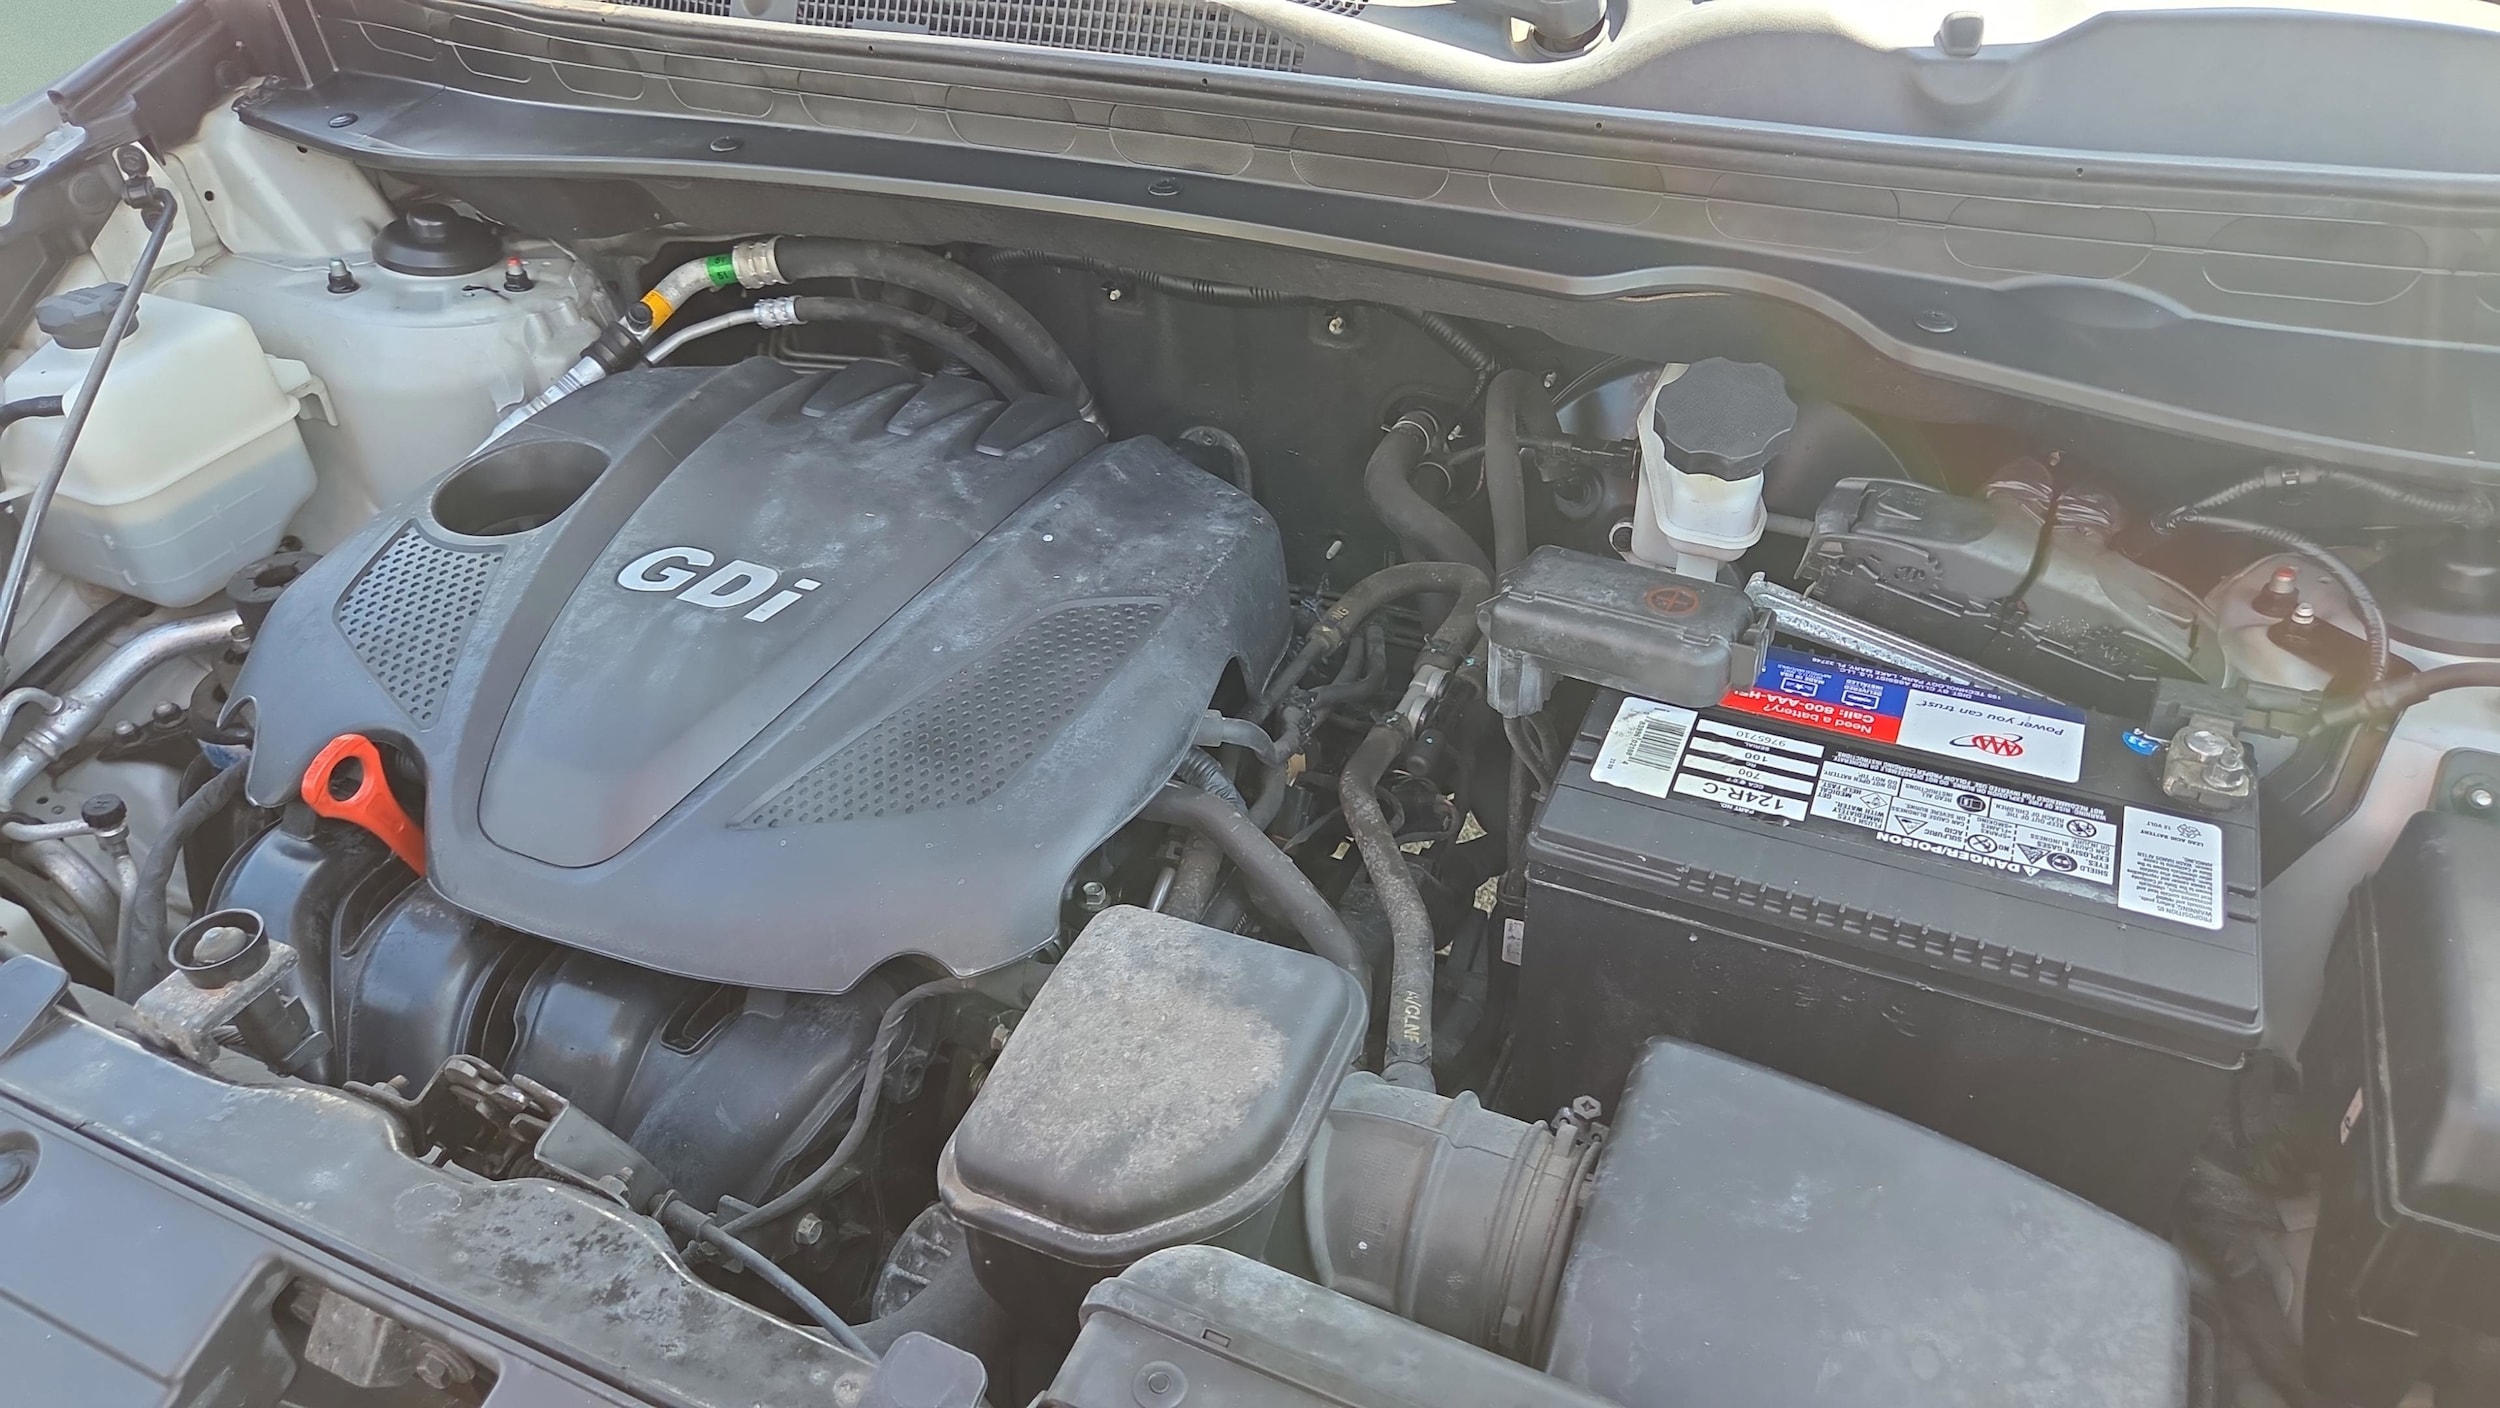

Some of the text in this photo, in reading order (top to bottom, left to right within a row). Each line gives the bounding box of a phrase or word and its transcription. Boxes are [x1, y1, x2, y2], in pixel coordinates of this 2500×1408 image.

[617, 546, 822, 623] GDi
[1804, 676, 1824, 685] MADE
[1874, 670, 1898, 679] LAKE
[1846, 678, 1883, 691] INSTALLED
[1911, 682, 1935, 692] CLUB
[1762, 702, 1872, 734] Need a battery?
[1838, 708, 1874, 724] Call:
[1959, 707, 1983, 718] can
[1986, 713, 2015, 725] you
[2017, 720, 2064, 737] Power
[1736, 729, 1786, 748] 9765710
[1744, 741, 1770, 752] SERIAL
[1975, 734, 2020, 757] AAA
[1744, 751, 1768, 763] 100
[1738, 767, 1760, 780] 700
[1872, 775, 1886, 783] NOT
[1748, 781, 1764, 790] CCA
[1854, 776, 1871, 785] OPEN
[1872, 780, 1885, 788] NOT
[1702, 781, 1784, 811] 124R-C
[1817, 791, 1832, 800] GET
[1819, 786, 1852, 798] MEDICAL
[1842, 786, 1862, 795] HELP
[1935, 794, 1952, 803] READ
[1720, 802, 1755, 815] PART NO.
[1832, 806, 1883, 823] IMMEDIATELY
[1864, 808, 1884, 817] WITH
[1891, 805, 1927, 818] BLINDNESS
[1931, 809, 1954, 819] SEVERE
[1837, 813, 1882, 829] FLUSH EYES
[1929, 814, 1949, 823] CAUSE
[2031, 816, 2045, 824] OUT
[2042, 813, 2065, 823] REACH
[2047, 820, 2064, 828] KEEP
[1924, 828, 1962, 842] SULFURIC
[1944, 826, 1963, 836] ACID
[2140, 828, 2204, 847] LEAD ACID BATTERY
[1998, 844, 2009, 852] NO
[2030, 833, 2109, 856] CAN CAUSE BLINDNESS
[1876, 831, 2020, 873] DANGER/POISON
[2037, 840, 2109, 862] EXPLOSIVE GASES
[2085, 859, 2109, 870] EYES.
[2080, 865, 2109, 877] SHIELD
